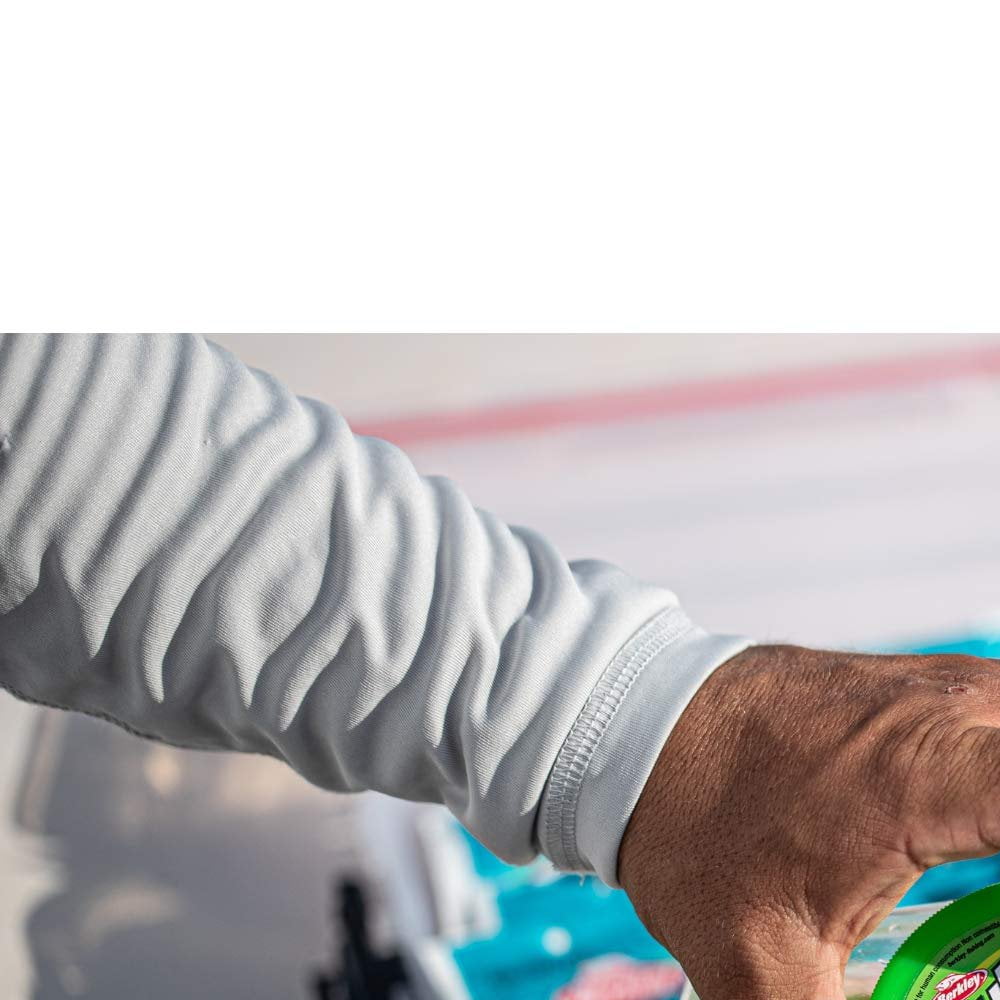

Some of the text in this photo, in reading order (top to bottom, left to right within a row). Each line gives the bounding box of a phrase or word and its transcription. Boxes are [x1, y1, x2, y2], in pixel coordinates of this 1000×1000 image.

[916, 991, 924, 999] for
[920, 972, 936, 990] human
[933, 942, 963, 972] consumption
